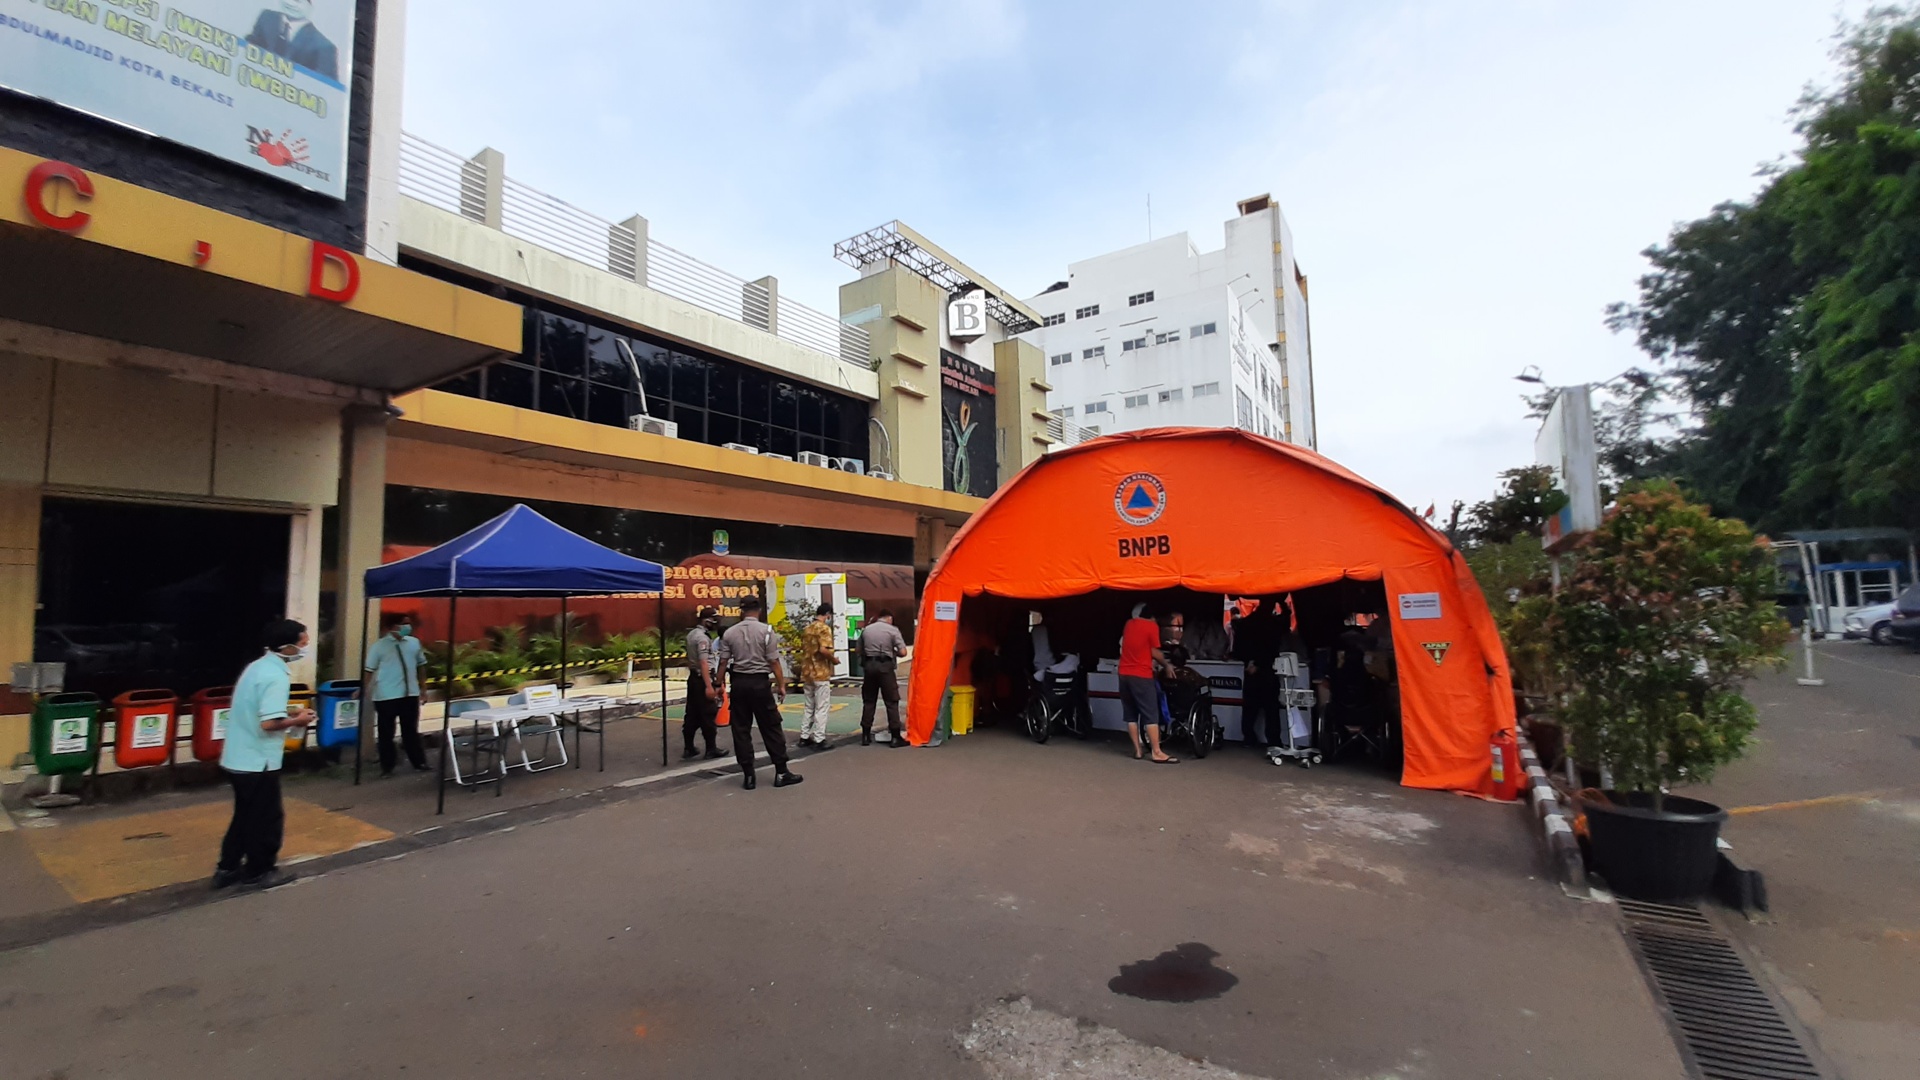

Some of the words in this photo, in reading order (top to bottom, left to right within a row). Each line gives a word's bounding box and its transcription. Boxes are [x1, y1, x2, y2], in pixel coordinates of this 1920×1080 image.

[104, 10, 231, 76] MELAYANI
[245, 43, 294, 79] DAN
[120, 56, 165, 81] KOTA
[171, 75, 235, 108] BEKASI
[955, 303, 980, 331] B
[1118, 535, 1171, 558] BNPB
[664, 565, 780, 581] endaftaran
[692, 583, 760, 598] Gawat
